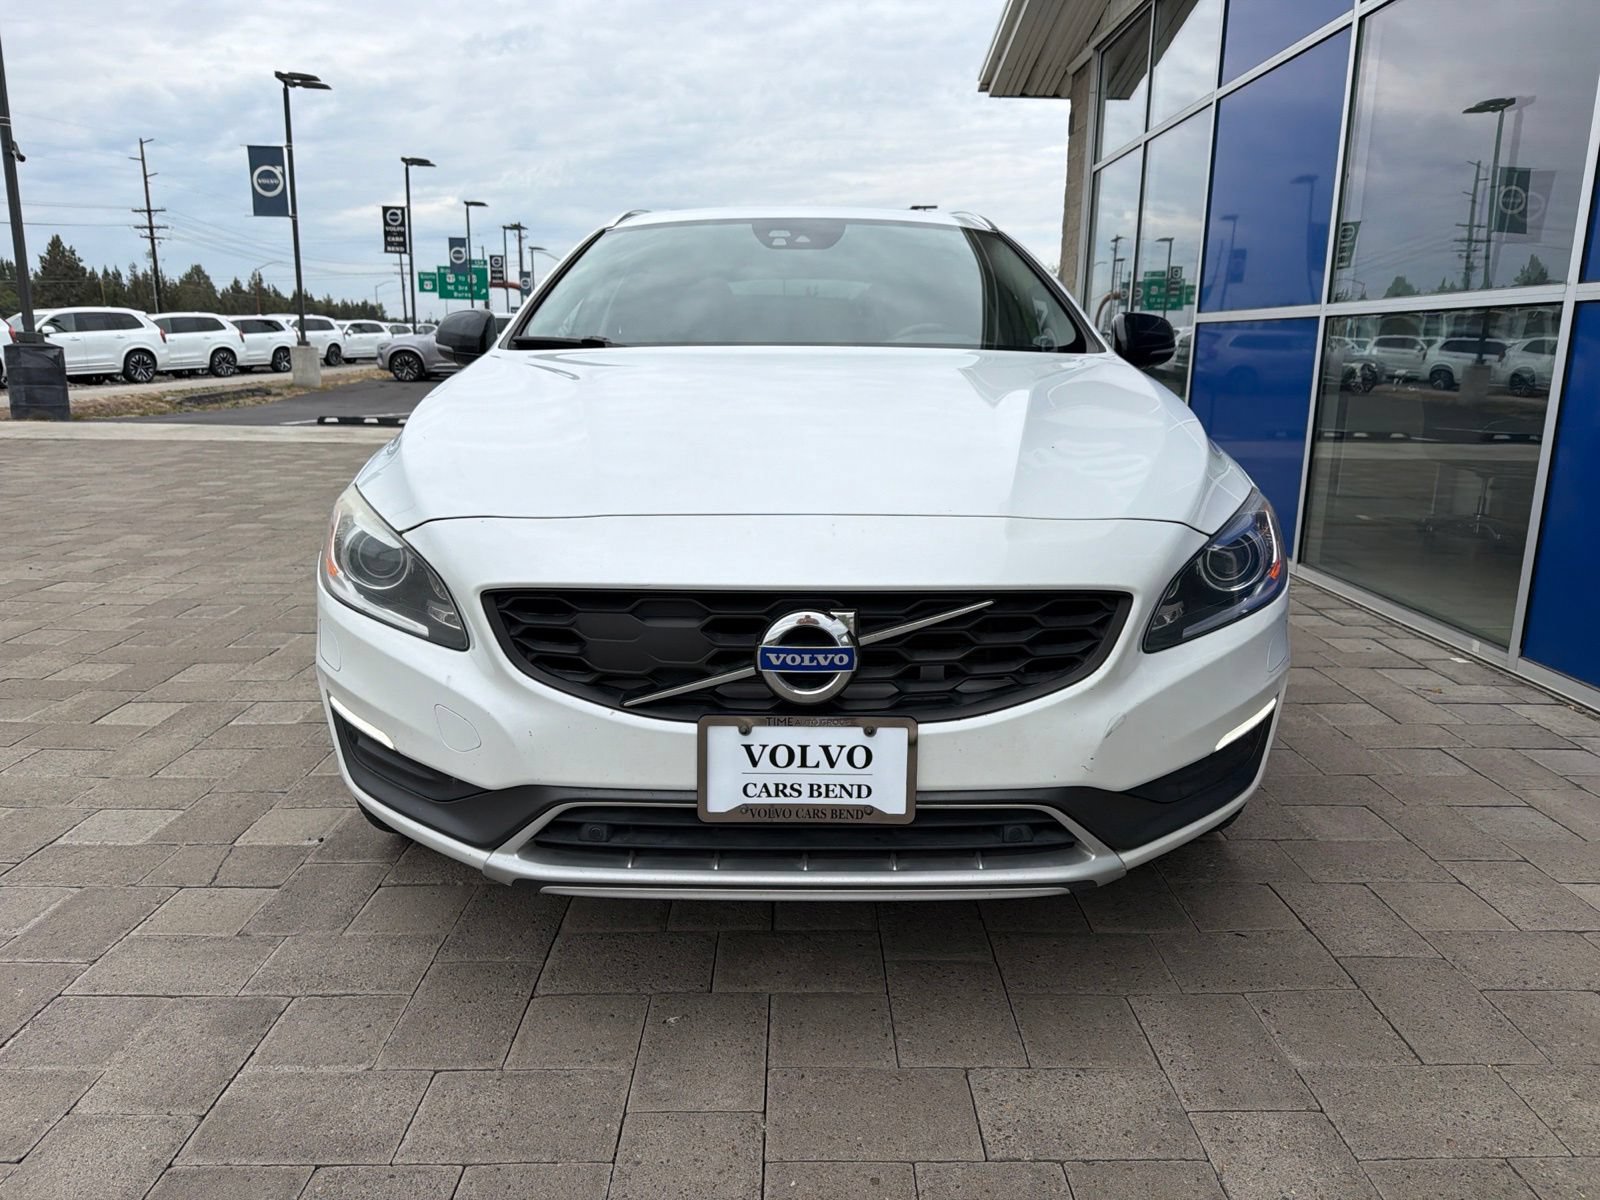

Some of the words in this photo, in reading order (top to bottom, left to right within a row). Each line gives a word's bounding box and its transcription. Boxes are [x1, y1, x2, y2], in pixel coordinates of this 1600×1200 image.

[766, 653, 849, 666] VOLVO
[766, 717, 793, 726] TIME
[741, 744, 873, 769] VOLVO
[742, 783, 802, 798] CARS
[808, 784, 872, 799] BEND
[750, 808, 792, 819] VOLVO
[796, 809, 828, 819] CARS
[830, 809, 864, 820] BEND
